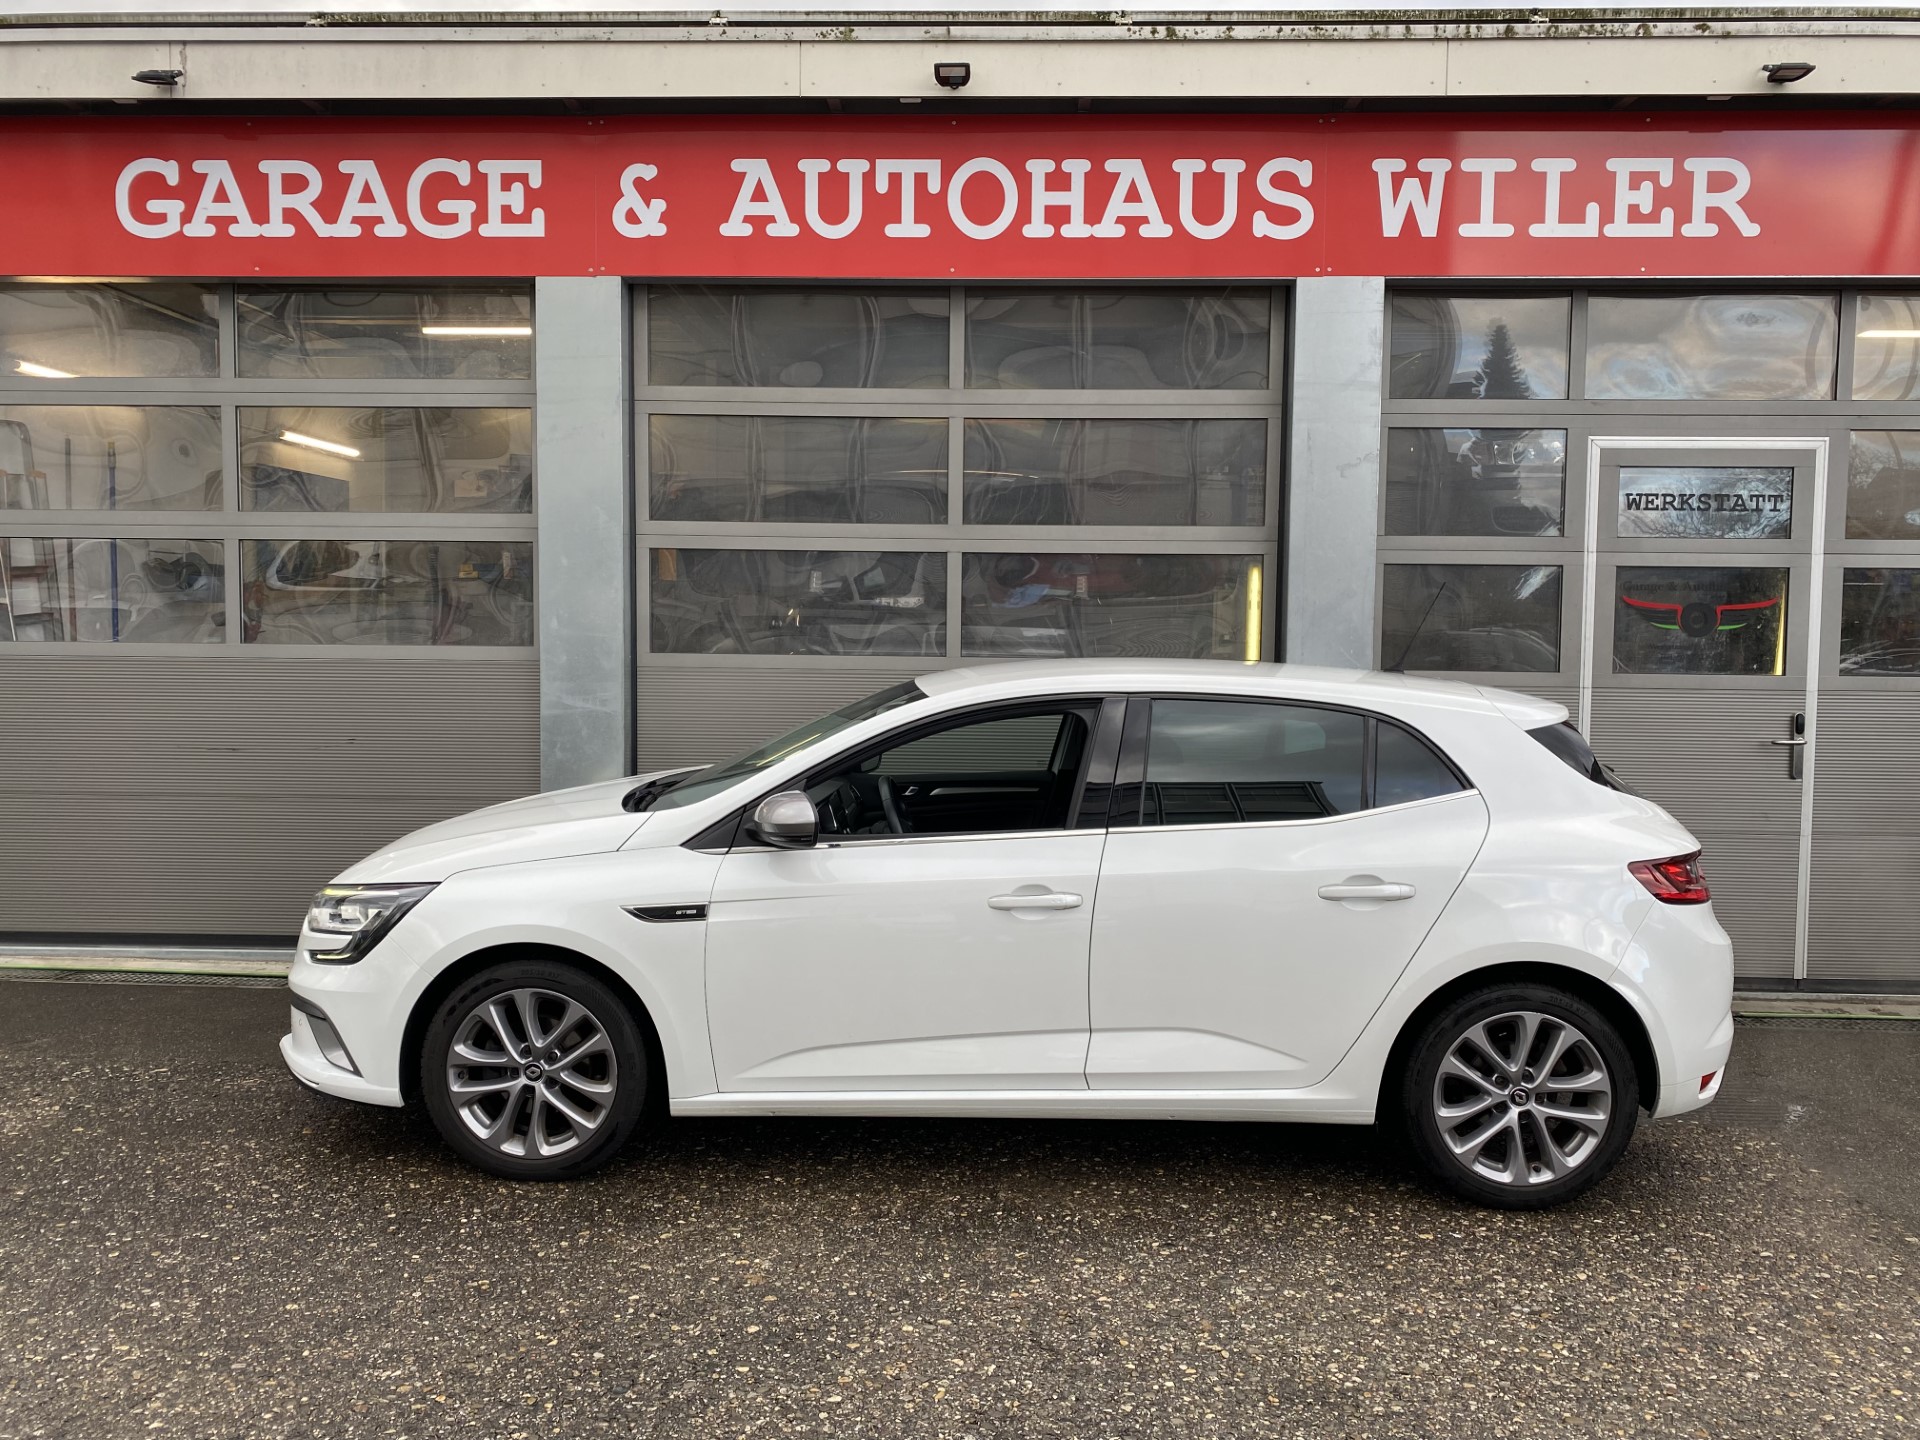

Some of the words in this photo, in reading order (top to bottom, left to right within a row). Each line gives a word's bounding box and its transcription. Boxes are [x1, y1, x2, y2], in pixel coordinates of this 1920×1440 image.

[115, 158, 545, 239] GARAGE
[612, 163, 667, 239] &
[719, 158, 1315, 240] AUTOHAUS
[1371, 158, 1761, 238] WILER
[1625, 493, 1784, 513] WERKSTATT
